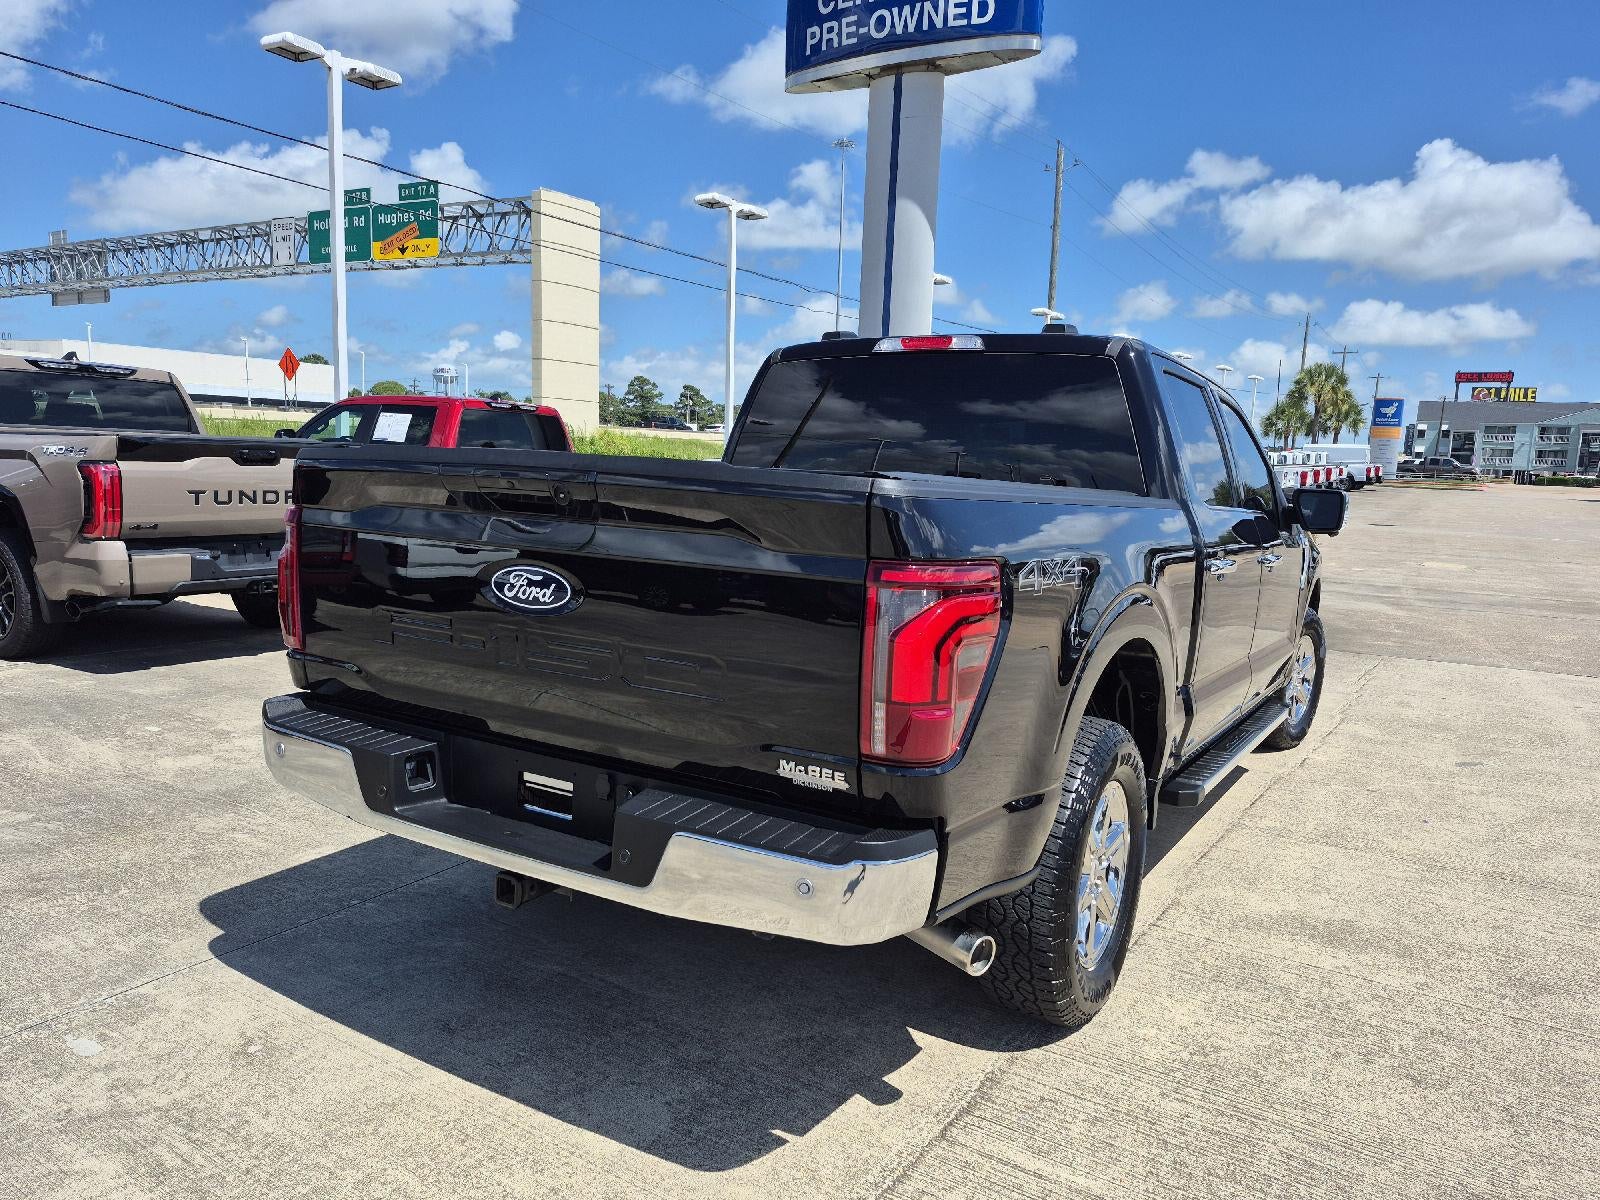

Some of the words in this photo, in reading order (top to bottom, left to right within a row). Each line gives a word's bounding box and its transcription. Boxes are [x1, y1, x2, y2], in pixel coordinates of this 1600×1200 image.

[805, 0, 996, 57] PRE-OWNED
[401, 187, 415, 197] EXIT
[418, 185, 427, 196] 17
[429, 184, 435, 195] A
[353, 215, 365, 228] Rd
[378, 211, 415, 226] Hughes
[419, 207, 432, 221] Rd
[273, 222, 293, 232] SPEED
[321, 246, 331, 254] EXI
[186, 489, 293, 506] TUND
[503, 571, 557, 603] Ford
[793, 777, 833, 793] DICKINSON
